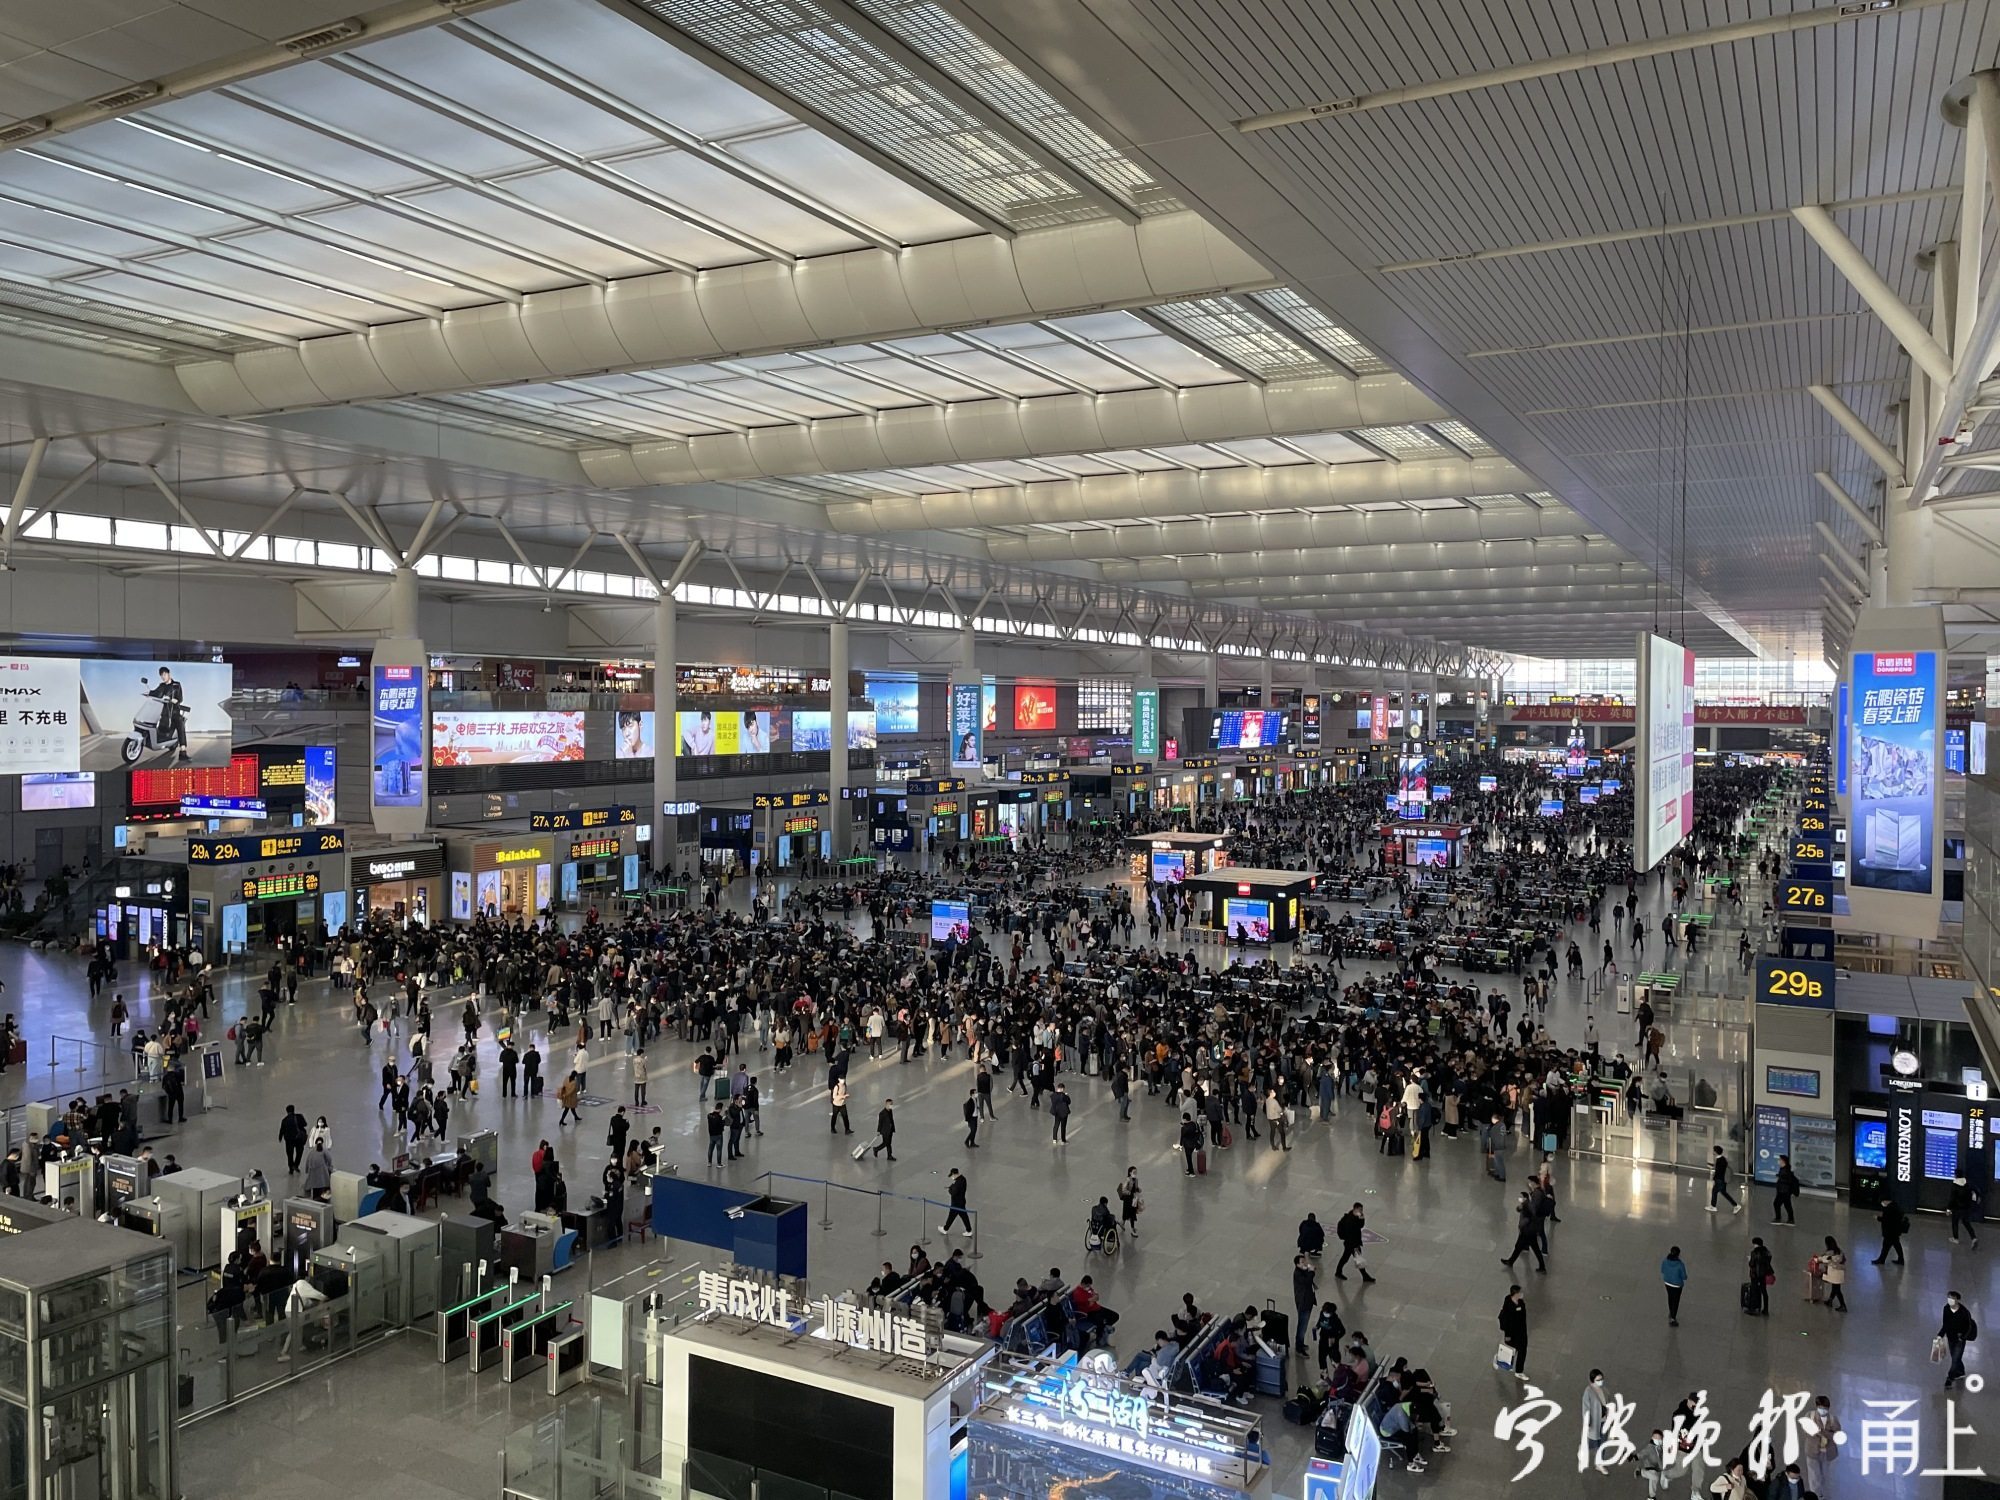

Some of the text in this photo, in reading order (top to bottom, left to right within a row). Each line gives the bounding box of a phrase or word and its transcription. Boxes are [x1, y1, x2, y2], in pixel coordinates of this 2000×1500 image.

[513, 669, 533, 678] KFC
[380, 687, 418, 699] 东鹏瓷砖
[1864, 687, 1925, 707] 东鹏瓷砖
[379, 699, 415, 711] 春季上新
[19, 710, 67, 725] 不充电
[956, 692, 971, 736] 好莱客
[1863, 706, 1921, 725] 春季上新
[1023, 774, 1035, 783] 21A
[755, 796, 784, 807] 25A 25A
[533, 815, 570, 828] 27A 27A
[620, 810, 635, 821] 26A
[1802, 818, 1825, 830] 23B
[320, 836, 342, 850] 28A
[192, 844, 240, 860] 29A 29A
[498, 849, 541, 863] Balabala
[1796, 843, 1825, 858] 25B
[370, 862, 393, 875] breo
[1787, 887, 1825, 906] 27B
[1769, 969, 1823, 998] 29B
[1969, 1108, 1984, 1117] 2F
[1975, 1118, 1984, 1149] 信息服务
[1897, 1107, 1912, 1182] LONGINES
